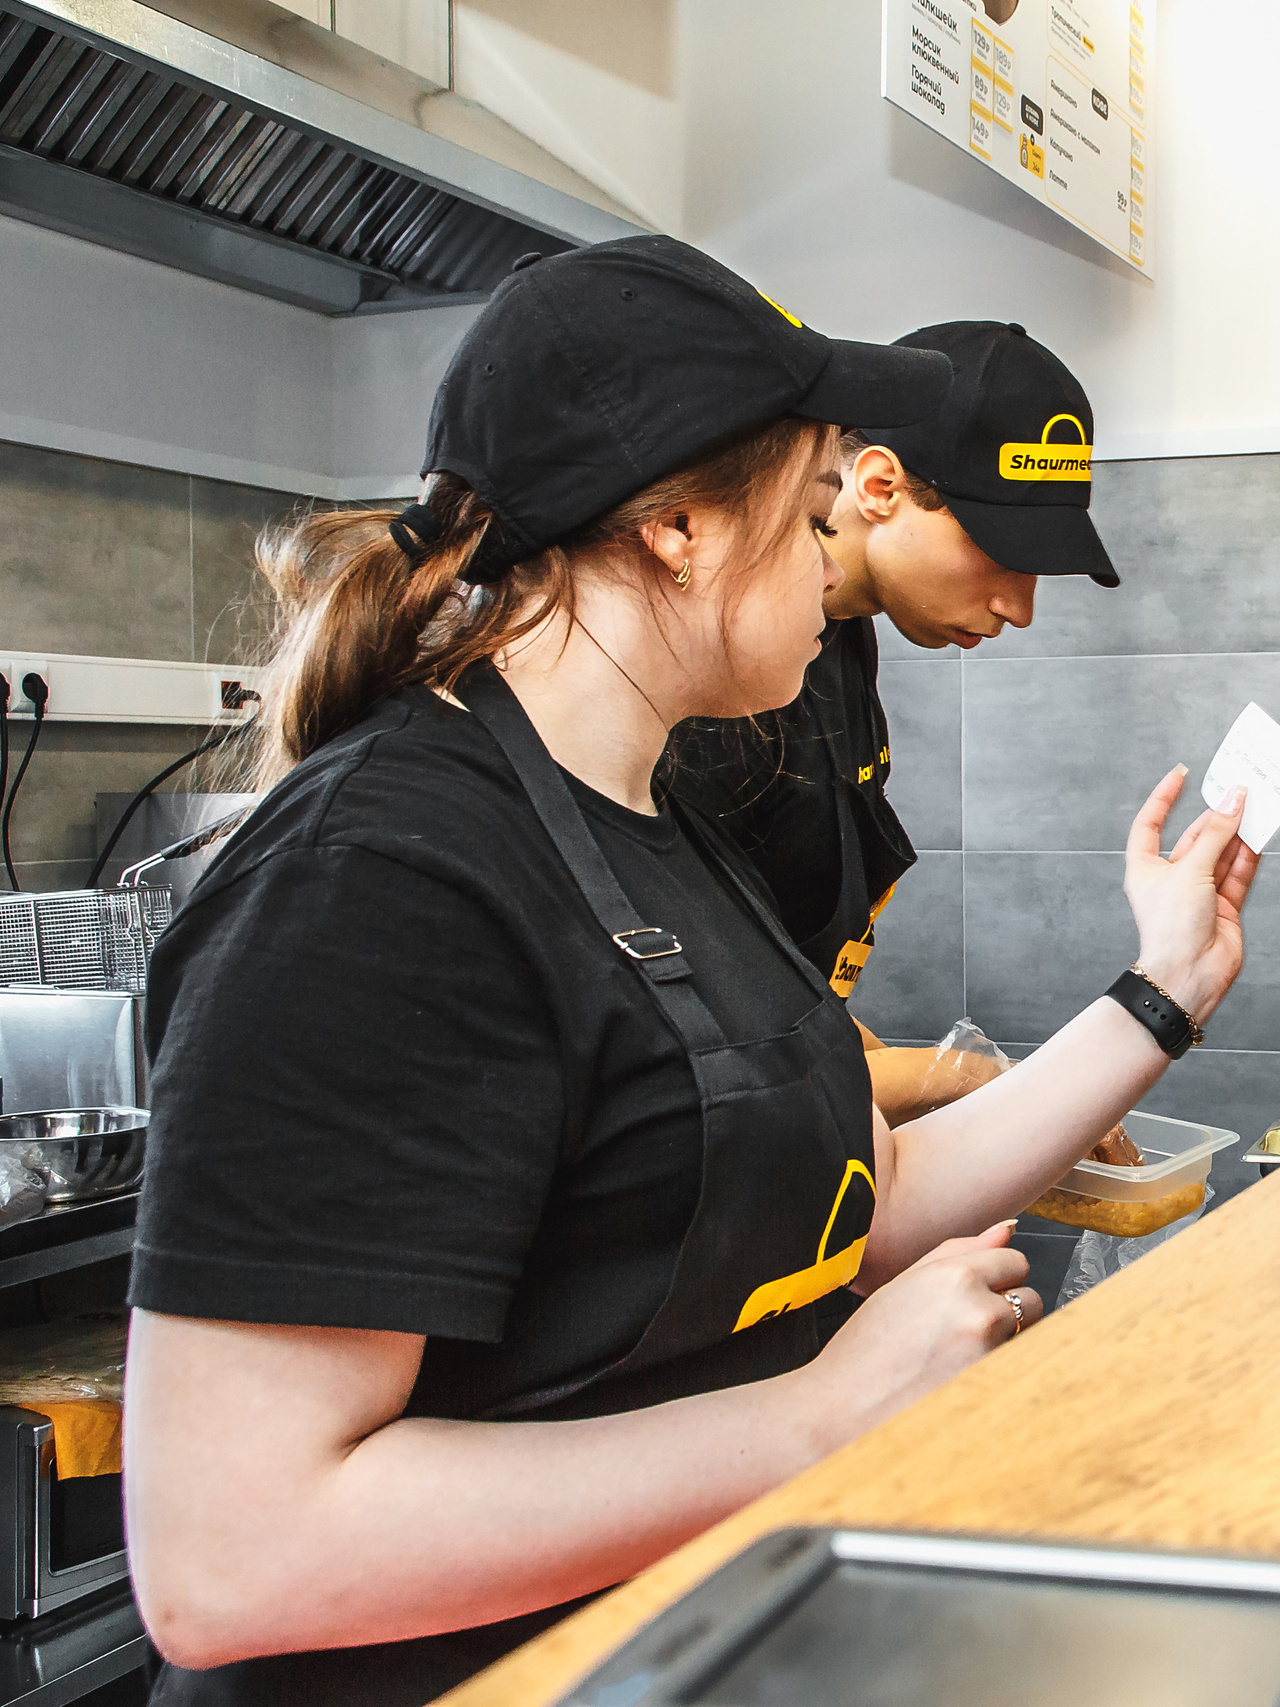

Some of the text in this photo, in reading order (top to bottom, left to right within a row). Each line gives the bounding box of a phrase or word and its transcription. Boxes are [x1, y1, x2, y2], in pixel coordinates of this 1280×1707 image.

[912, 24, 942, 57] Морсик
[912, 42, 960, 85] клюквенный
[912, 63, 942, 96] Горячий
[911, 81, 945, 115] шоколад
[1010, 454, 1091, 471] Shaurme
